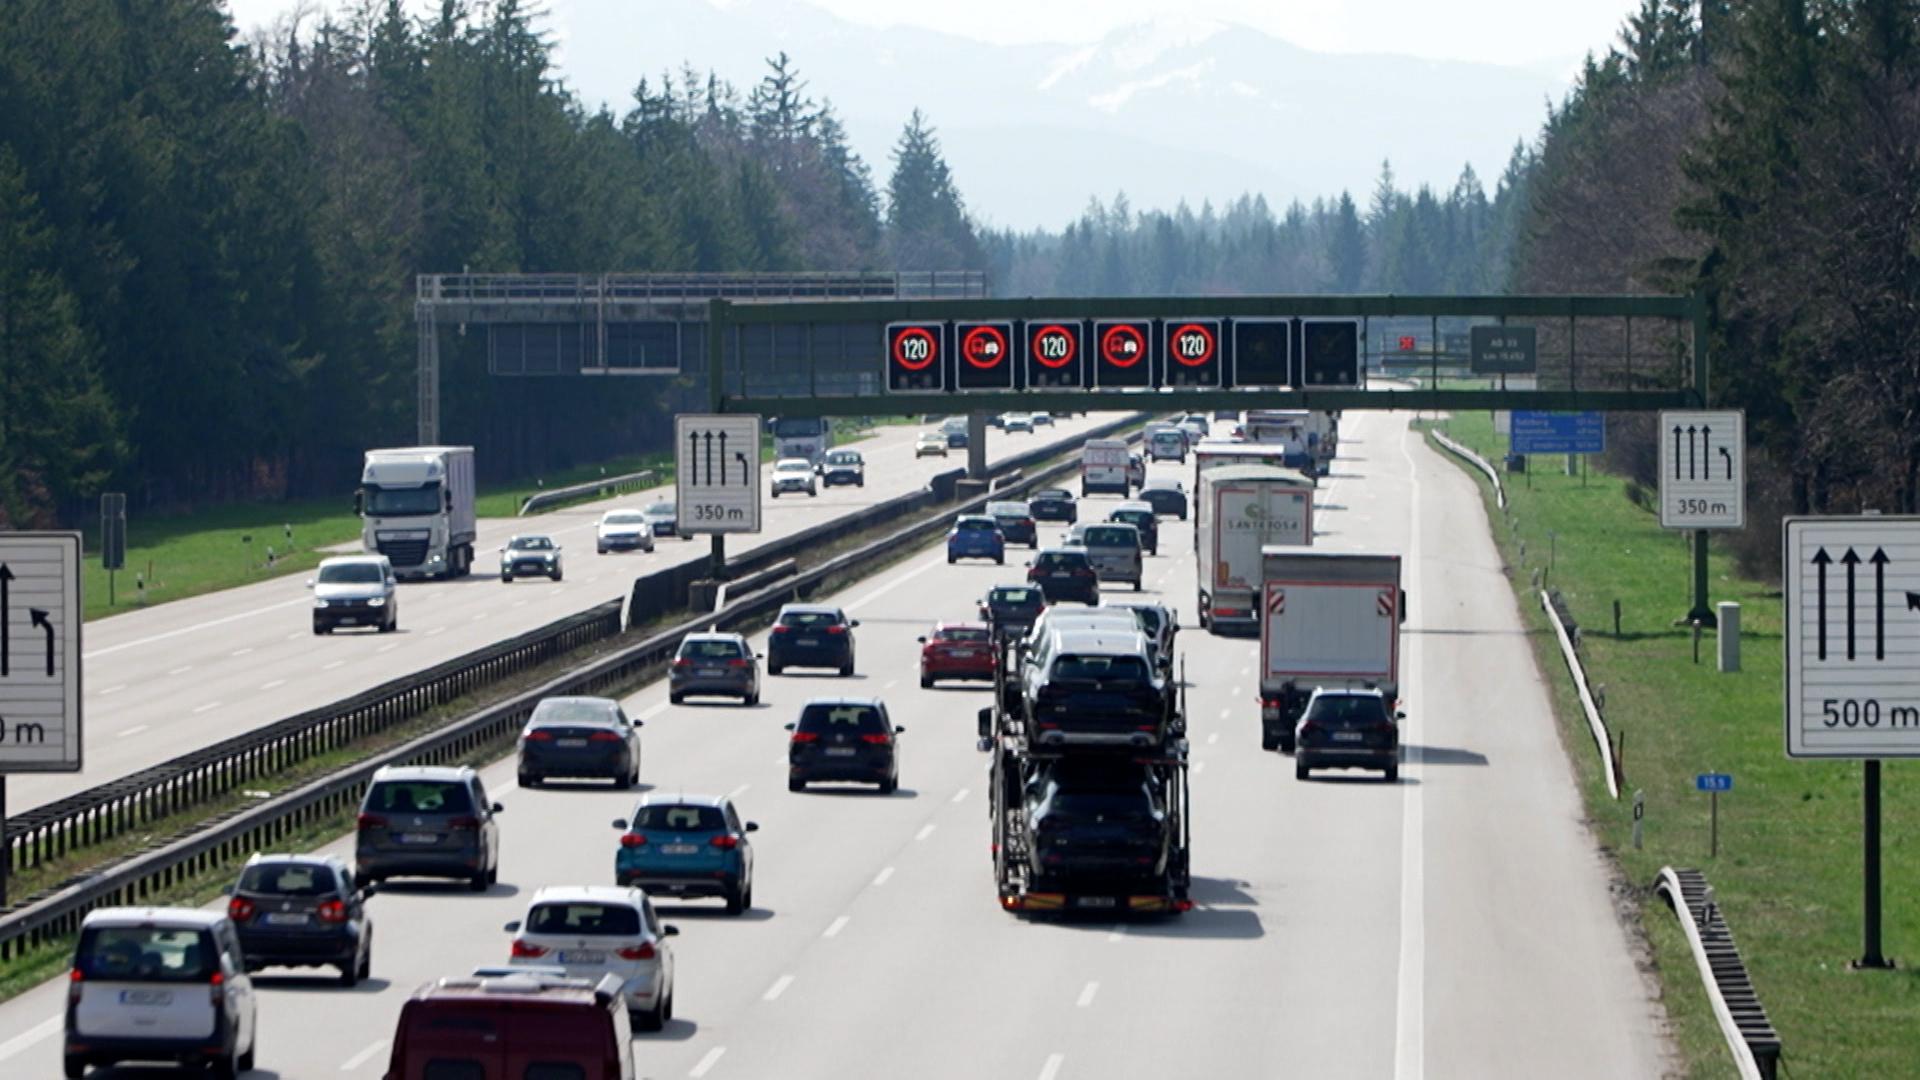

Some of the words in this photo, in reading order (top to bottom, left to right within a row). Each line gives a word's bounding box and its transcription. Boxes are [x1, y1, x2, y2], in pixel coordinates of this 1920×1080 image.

[903, 338, 928, 360] 120
[1041, 336, 1067, 357] 120
[1180, 335, 1205, 356] 120
[695, 504, 724, 520] 350
[727, 508, 744, 520] m
[1678, 499, 1708, 514] 350
[1711, 503, 1727, 514] m
[1823, 698, 1881, 728] 500
[1890, 706, 1920, 727] m
[16, 722, 44, 744] m
